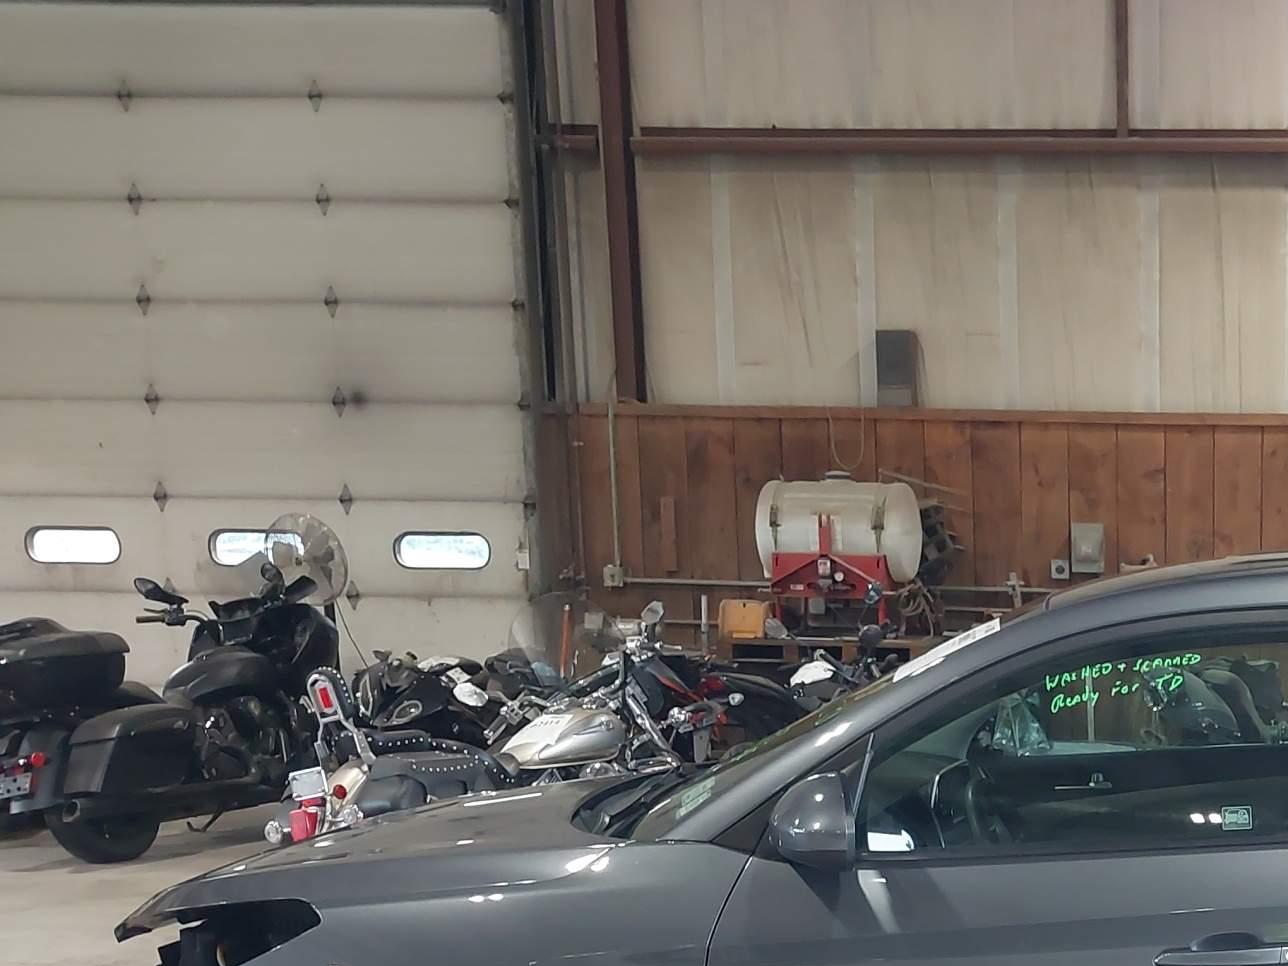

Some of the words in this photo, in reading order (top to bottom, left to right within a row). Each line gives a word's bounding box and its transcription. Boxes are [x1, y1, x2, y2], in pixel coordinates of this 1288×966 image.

[1046, 662, 1113, 691] WASHED
[1133, 653, 1201, 673] SCANNED
[1155, 673, 1184, 692] TD
